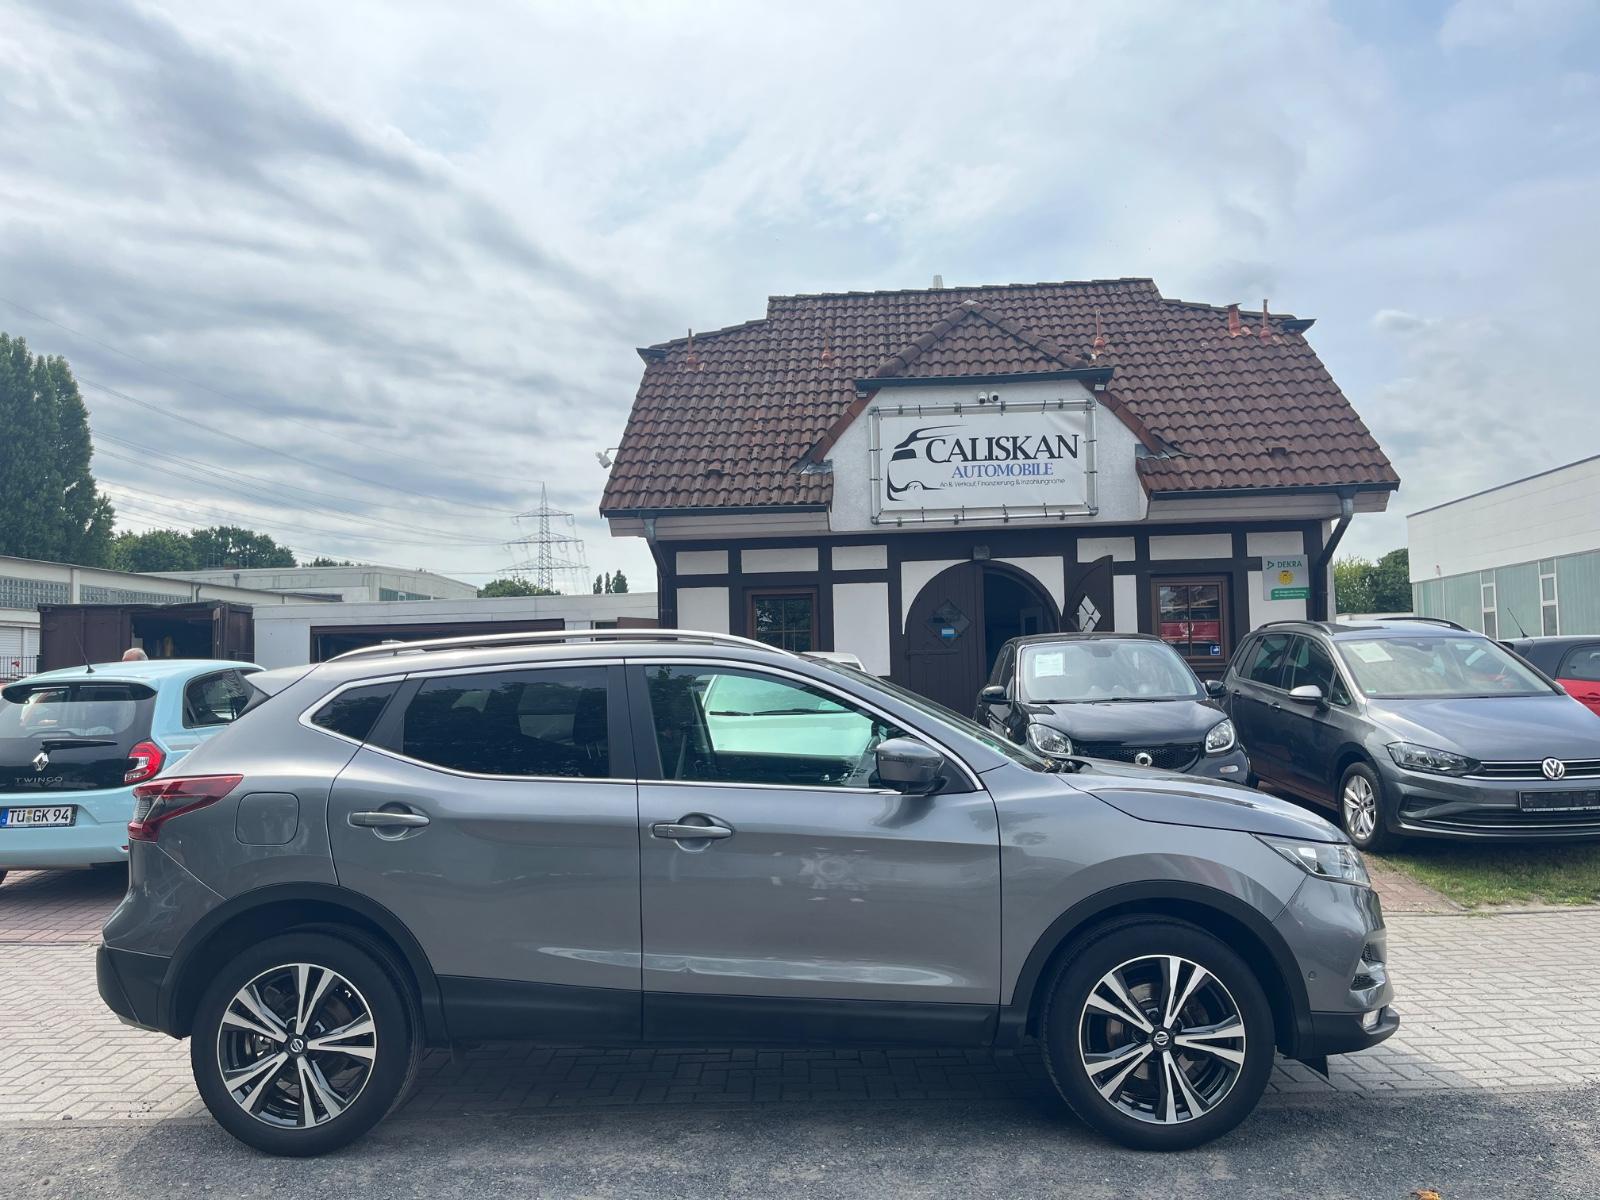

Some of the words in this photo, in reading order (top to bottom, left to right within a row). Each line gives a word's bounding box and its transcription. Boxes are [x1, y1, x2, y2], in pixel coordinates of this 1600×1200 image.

[925, 434, 1079, 463] CALISKAN
[952, 462, 1053, 478] AUTOMOBILE
[1277, 560, 1302, 568] DEKRA
[33, 809, 50, 822] GK
[53, 808, 69, 822] 94
